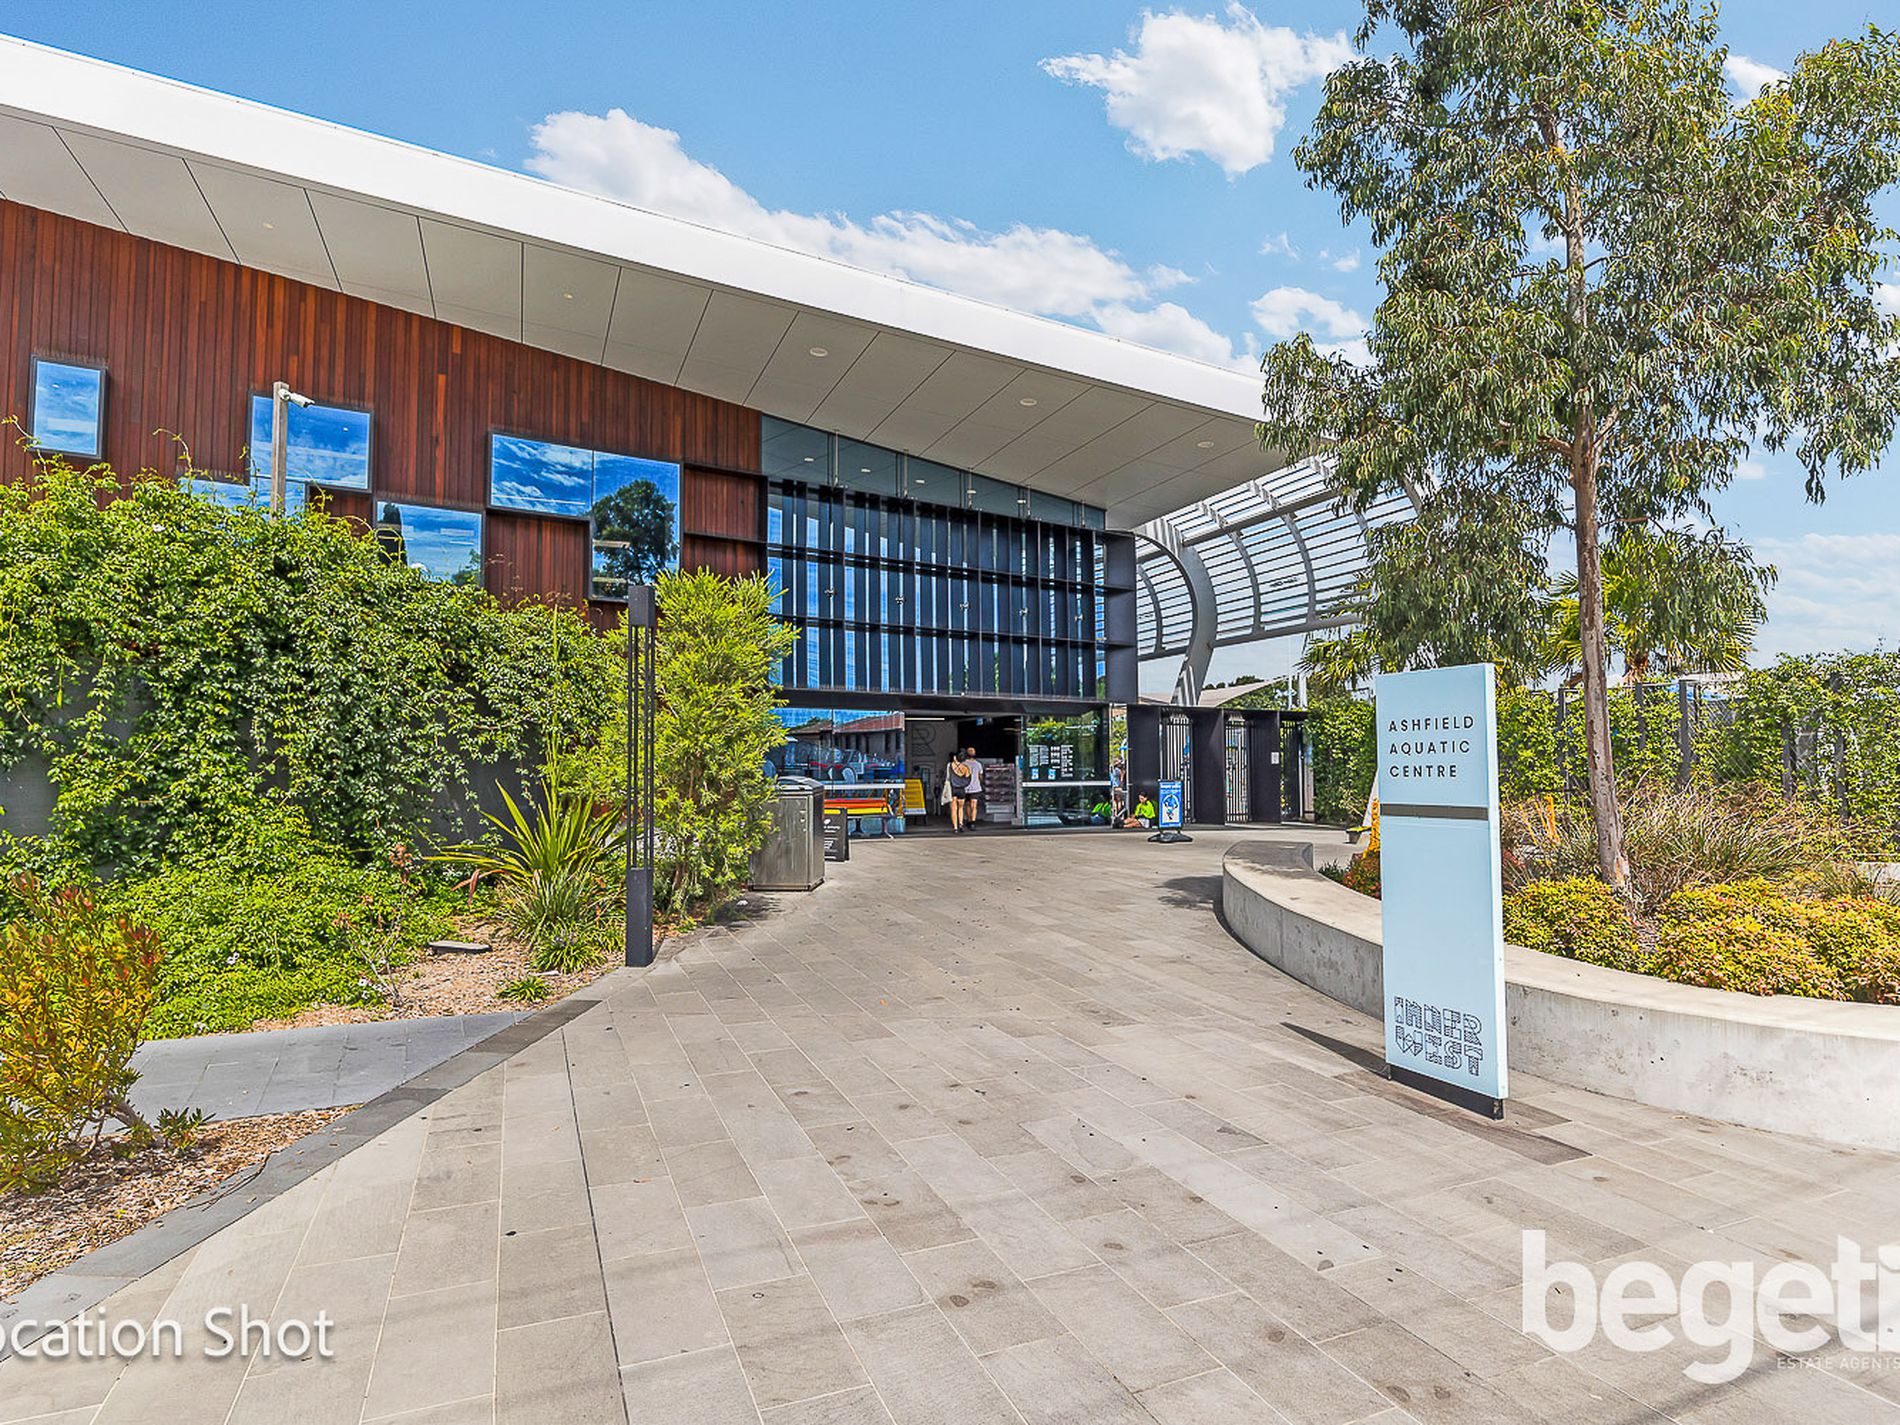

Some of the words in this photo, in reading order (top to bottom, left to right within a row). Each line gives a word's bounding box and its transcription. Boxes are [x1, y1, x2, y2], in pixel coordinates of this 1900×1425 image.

[1388, 716, 1474, 732] ASHFIELD
[1389, 741, 1471, 756] AQUATIC
[1389, 765, 1458, 778] CENTRE
[1394, 996, 1482, 1046] INNER
[1395, 1025, 1483, 1076] WEST
